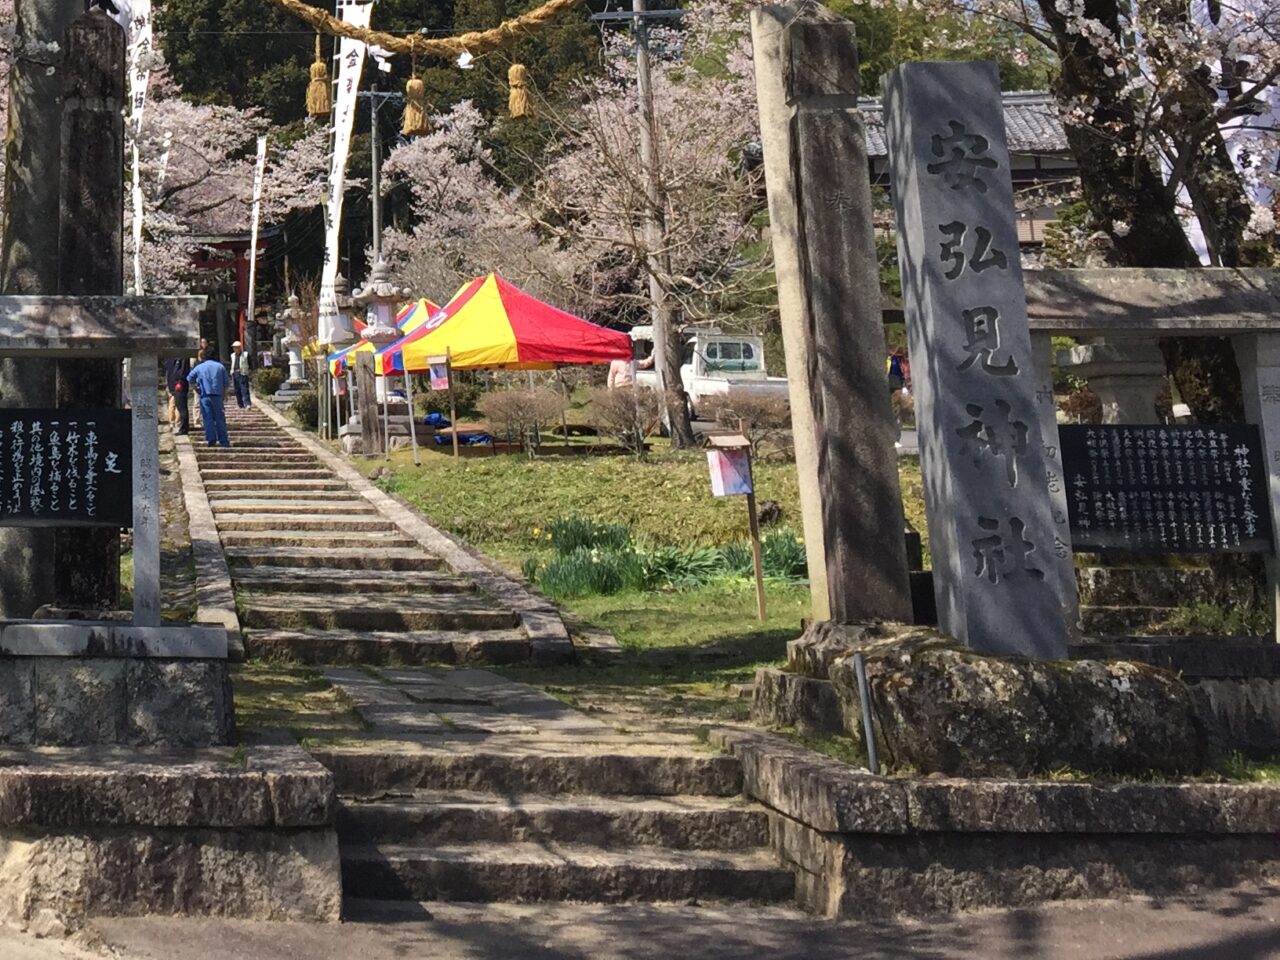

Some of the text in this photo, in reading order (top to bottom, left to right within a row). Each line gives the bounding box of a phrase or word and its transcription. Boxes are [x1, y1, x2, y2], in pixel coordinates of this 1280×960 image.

[926, 119, 1044, 584] 安弘見神社
